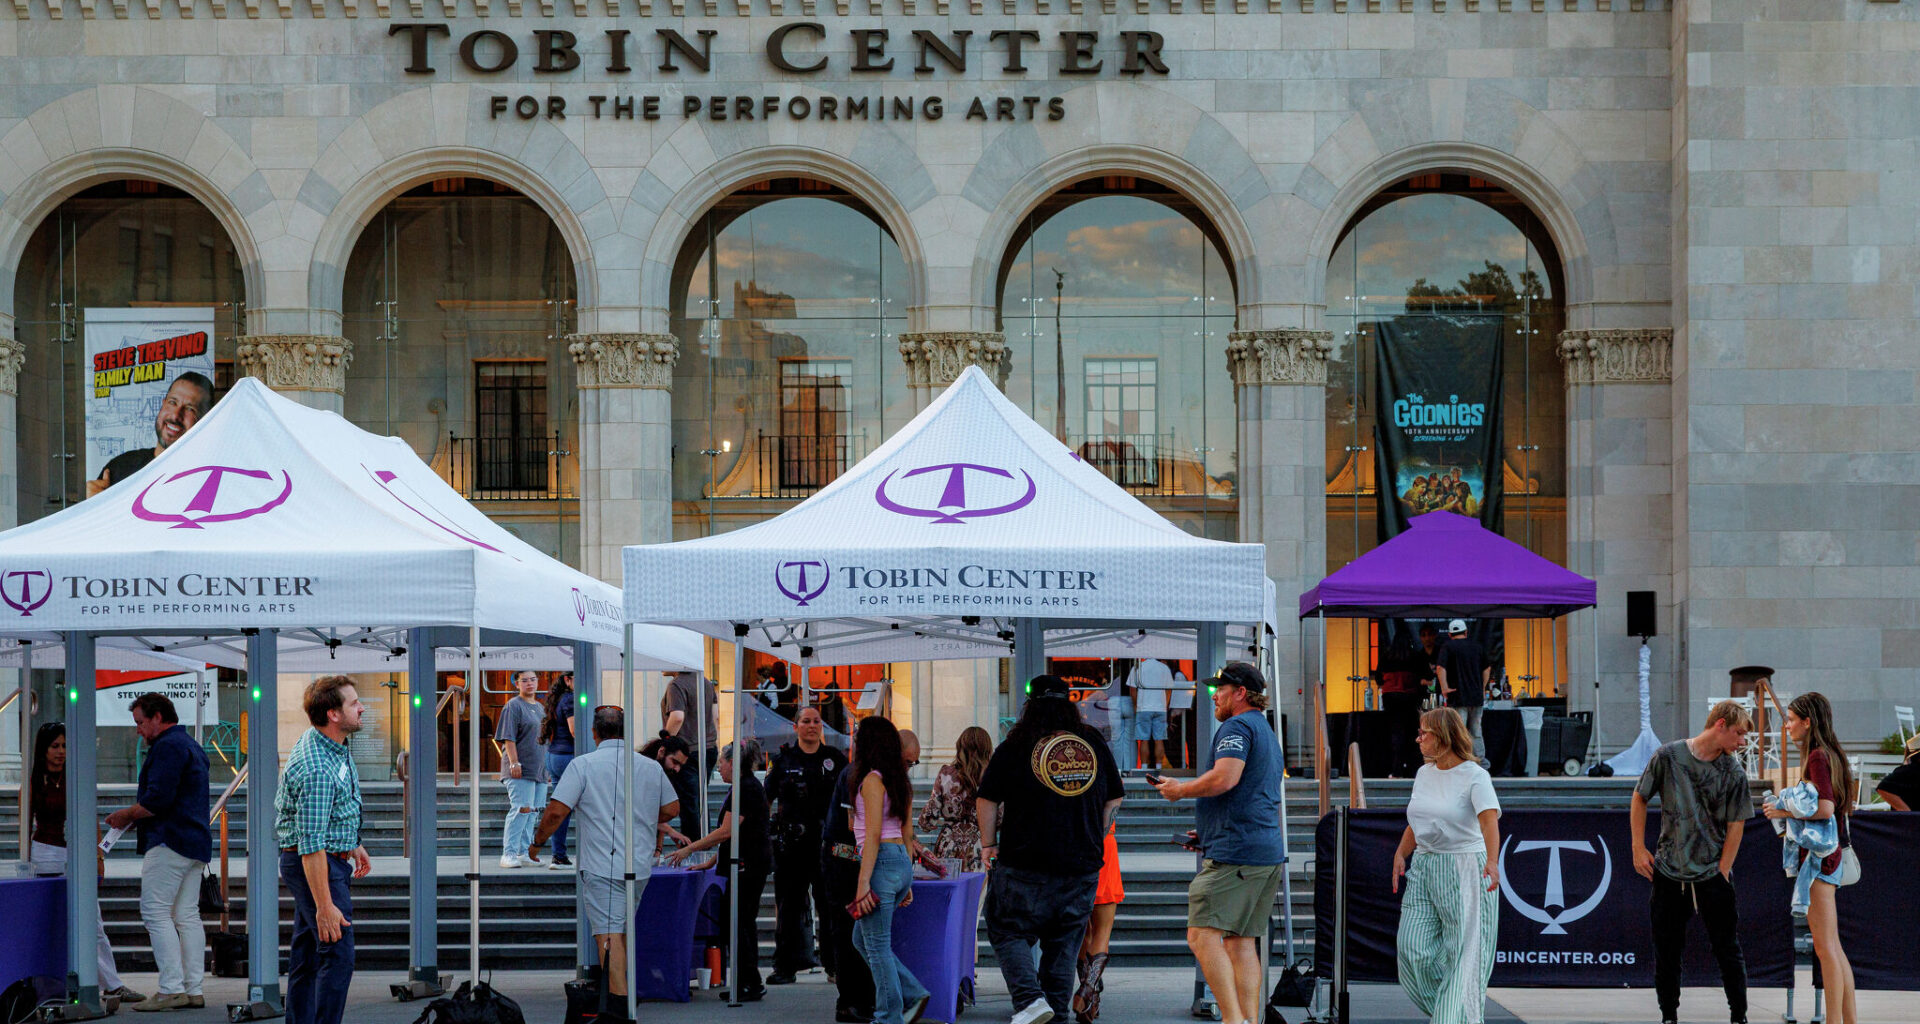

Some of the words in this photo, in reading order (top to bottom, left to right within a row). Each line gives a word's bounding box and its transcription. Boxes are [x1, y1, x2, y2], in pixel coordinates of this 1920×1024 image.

[387, 22, 718, 74] TOBIN
[765, 21, 1171, 75] CENTER
[490, 95, 567, 121] FOR
[588, 95, 661, 121] THE
[683, 95, 944, 121] PERFORMING
[965, 96, 1066, 121] ARTS
[94, 346, 136, 373] STEVE
[136, 331, 209, 364] TREVINO
[94, 367, 132, 388] FAMILY
[133, 362, 165, 384] MAN
[94, 385, 111, 399] TOUR
[62, 575, 169, 599] TOBIN
[839, 565, 949, 589] TOBIN
[81, 604, 111, 615] FOR
[118, 603, 146, 615] THE
[153, 602, 251, 614] PERFORMING
[259, 602, 296, 613] ARTS
[859, 595, 889, 605] FOR
[896, 594, 925, 604] THE
[932, 594, 1033, 606] PERFORMING
[1041, 596, 1080, 607] ARTS
[1047, 759, 1092, 775] Cowboy
[1496, 951, 1636, 965] BINCENTER.ORG
